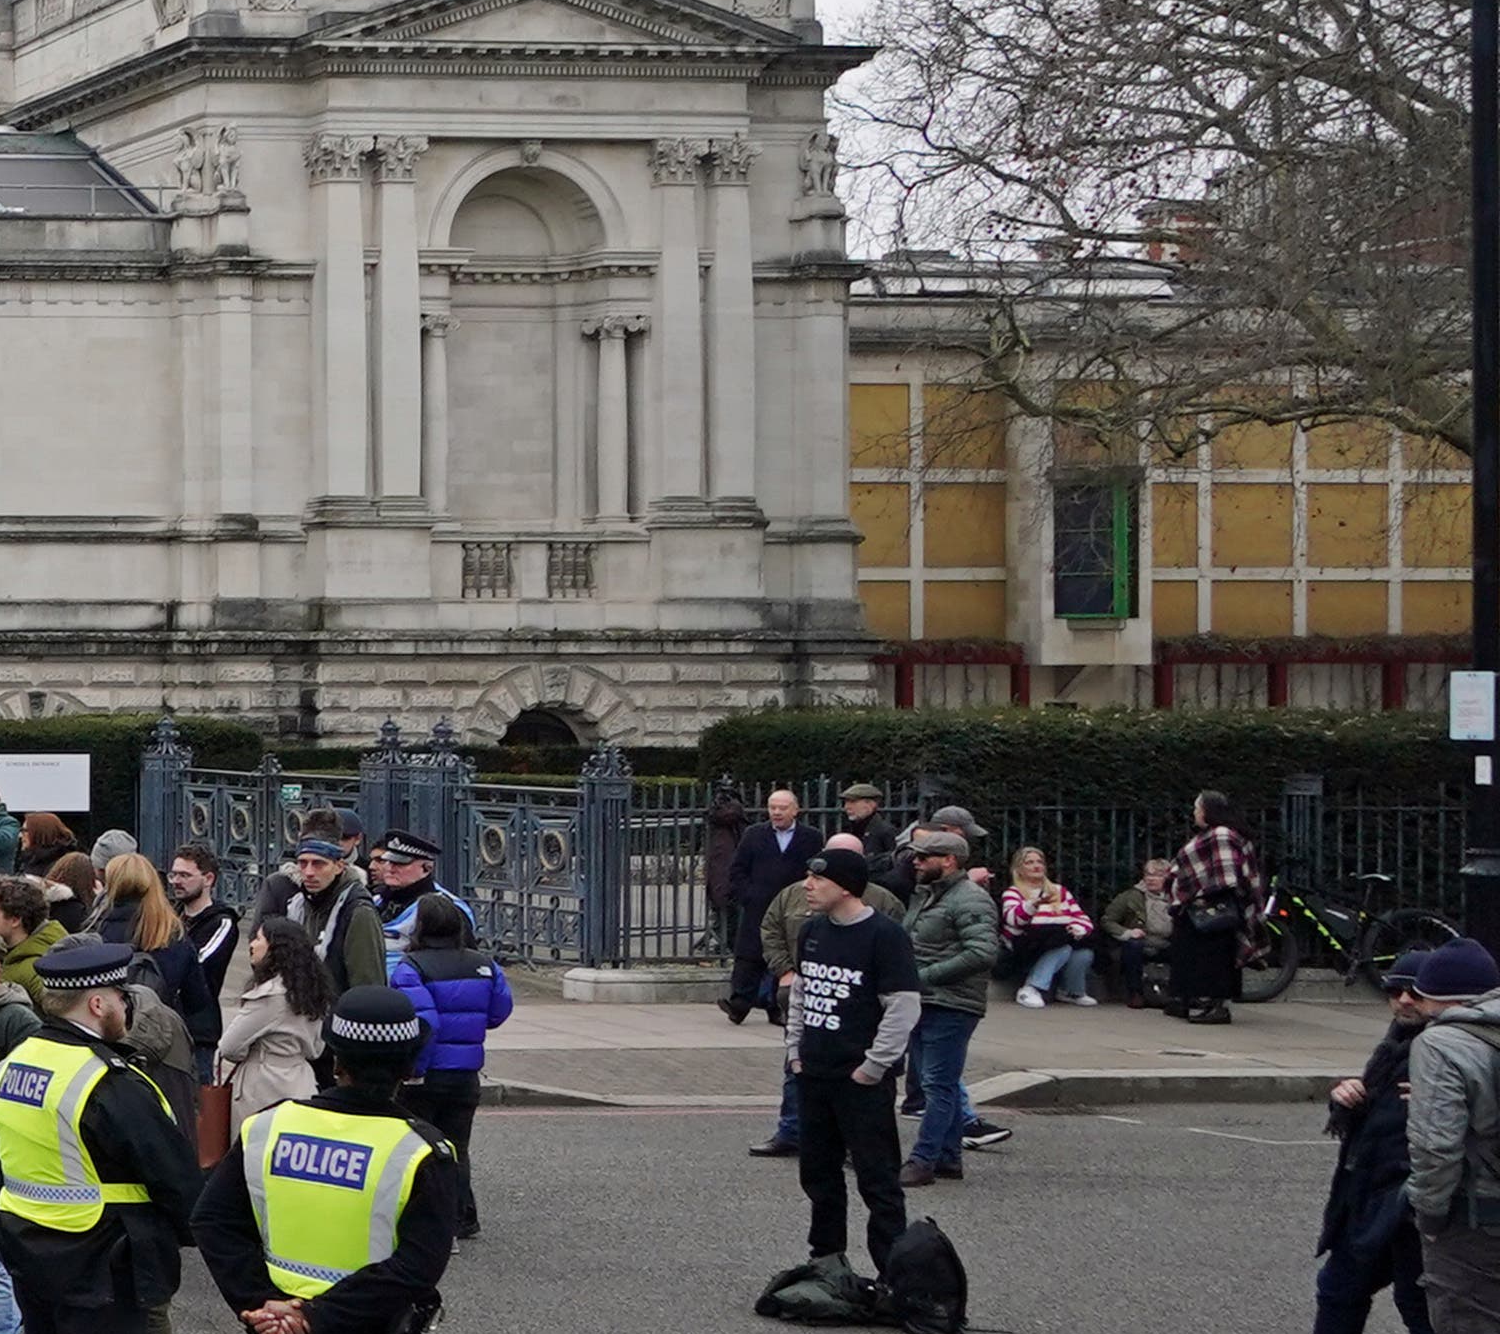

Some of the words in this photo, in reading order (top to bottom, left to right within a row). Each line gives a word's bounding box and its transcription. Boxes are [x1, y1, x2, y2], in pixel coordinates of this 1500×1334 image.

[801, 960, 863, 986] GROOM
[804, 993, 838, 1014] NOT
[0, 1067, 48, 1102] POLICE
[273, 1138, 364, 1183] POLICE
